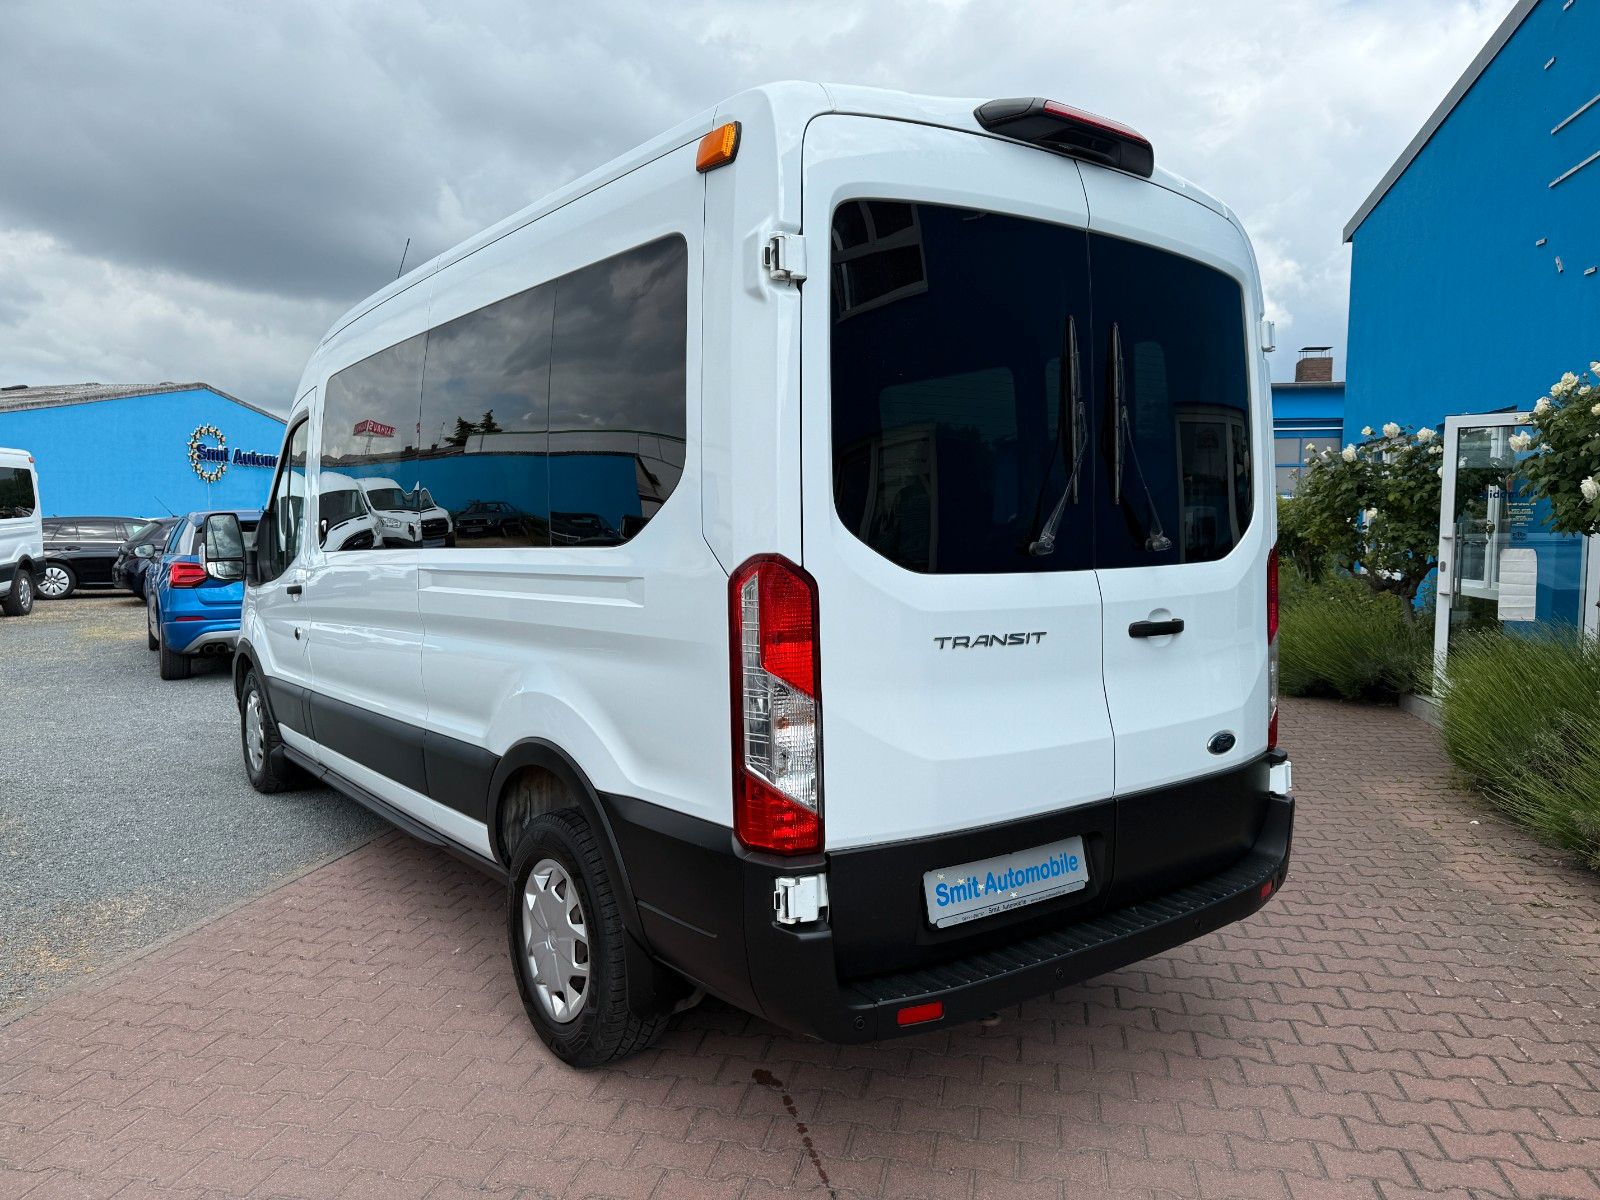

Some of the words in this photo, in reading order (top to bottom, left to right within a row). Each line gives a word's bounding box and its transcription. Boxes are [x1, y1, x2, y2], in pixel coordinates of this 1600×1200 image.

[197, 443, 230, 462] Smit
[933, 631, 1047, 650] TRANSIT
[935, 876, 981, 907] Smit
[984, 853, 1079, 896] Automobile
